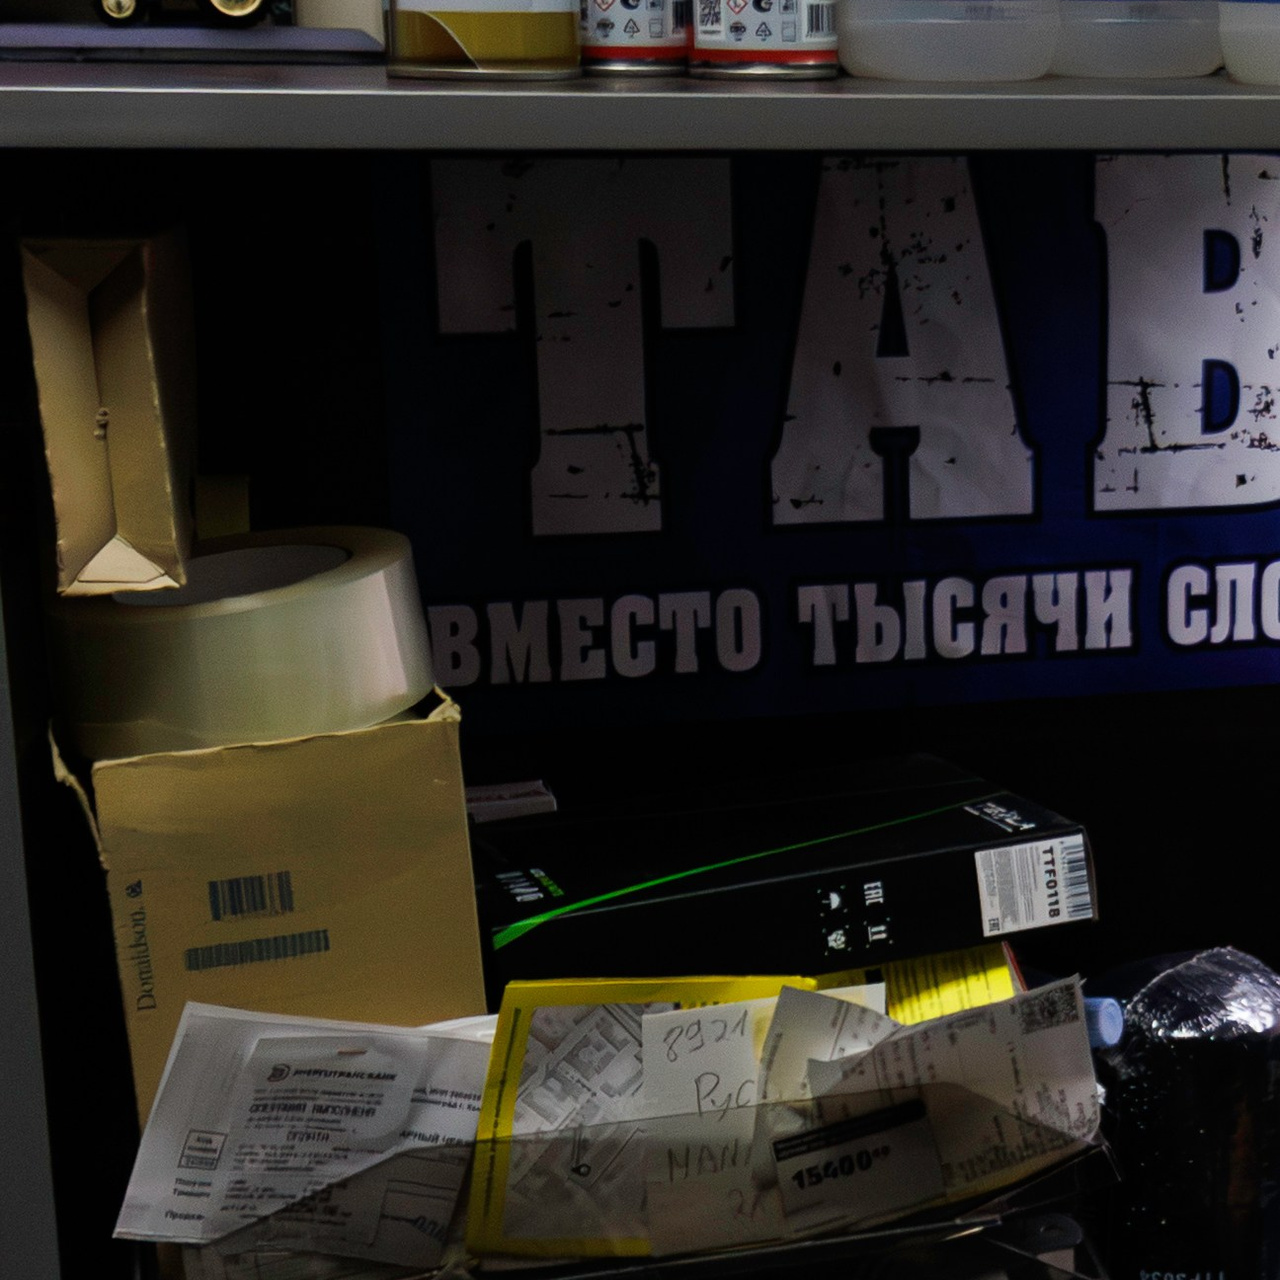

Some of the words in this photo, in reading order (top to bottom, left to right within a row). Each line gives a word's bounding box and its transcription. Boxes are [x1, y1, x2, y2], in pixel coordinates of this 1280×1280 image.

[429, 586, 761, 688] ВМЕСТО
[799, 568, 1133, 666] ТЫСЯЧИ
[1042, 845, 1061, 919] TTF0118
